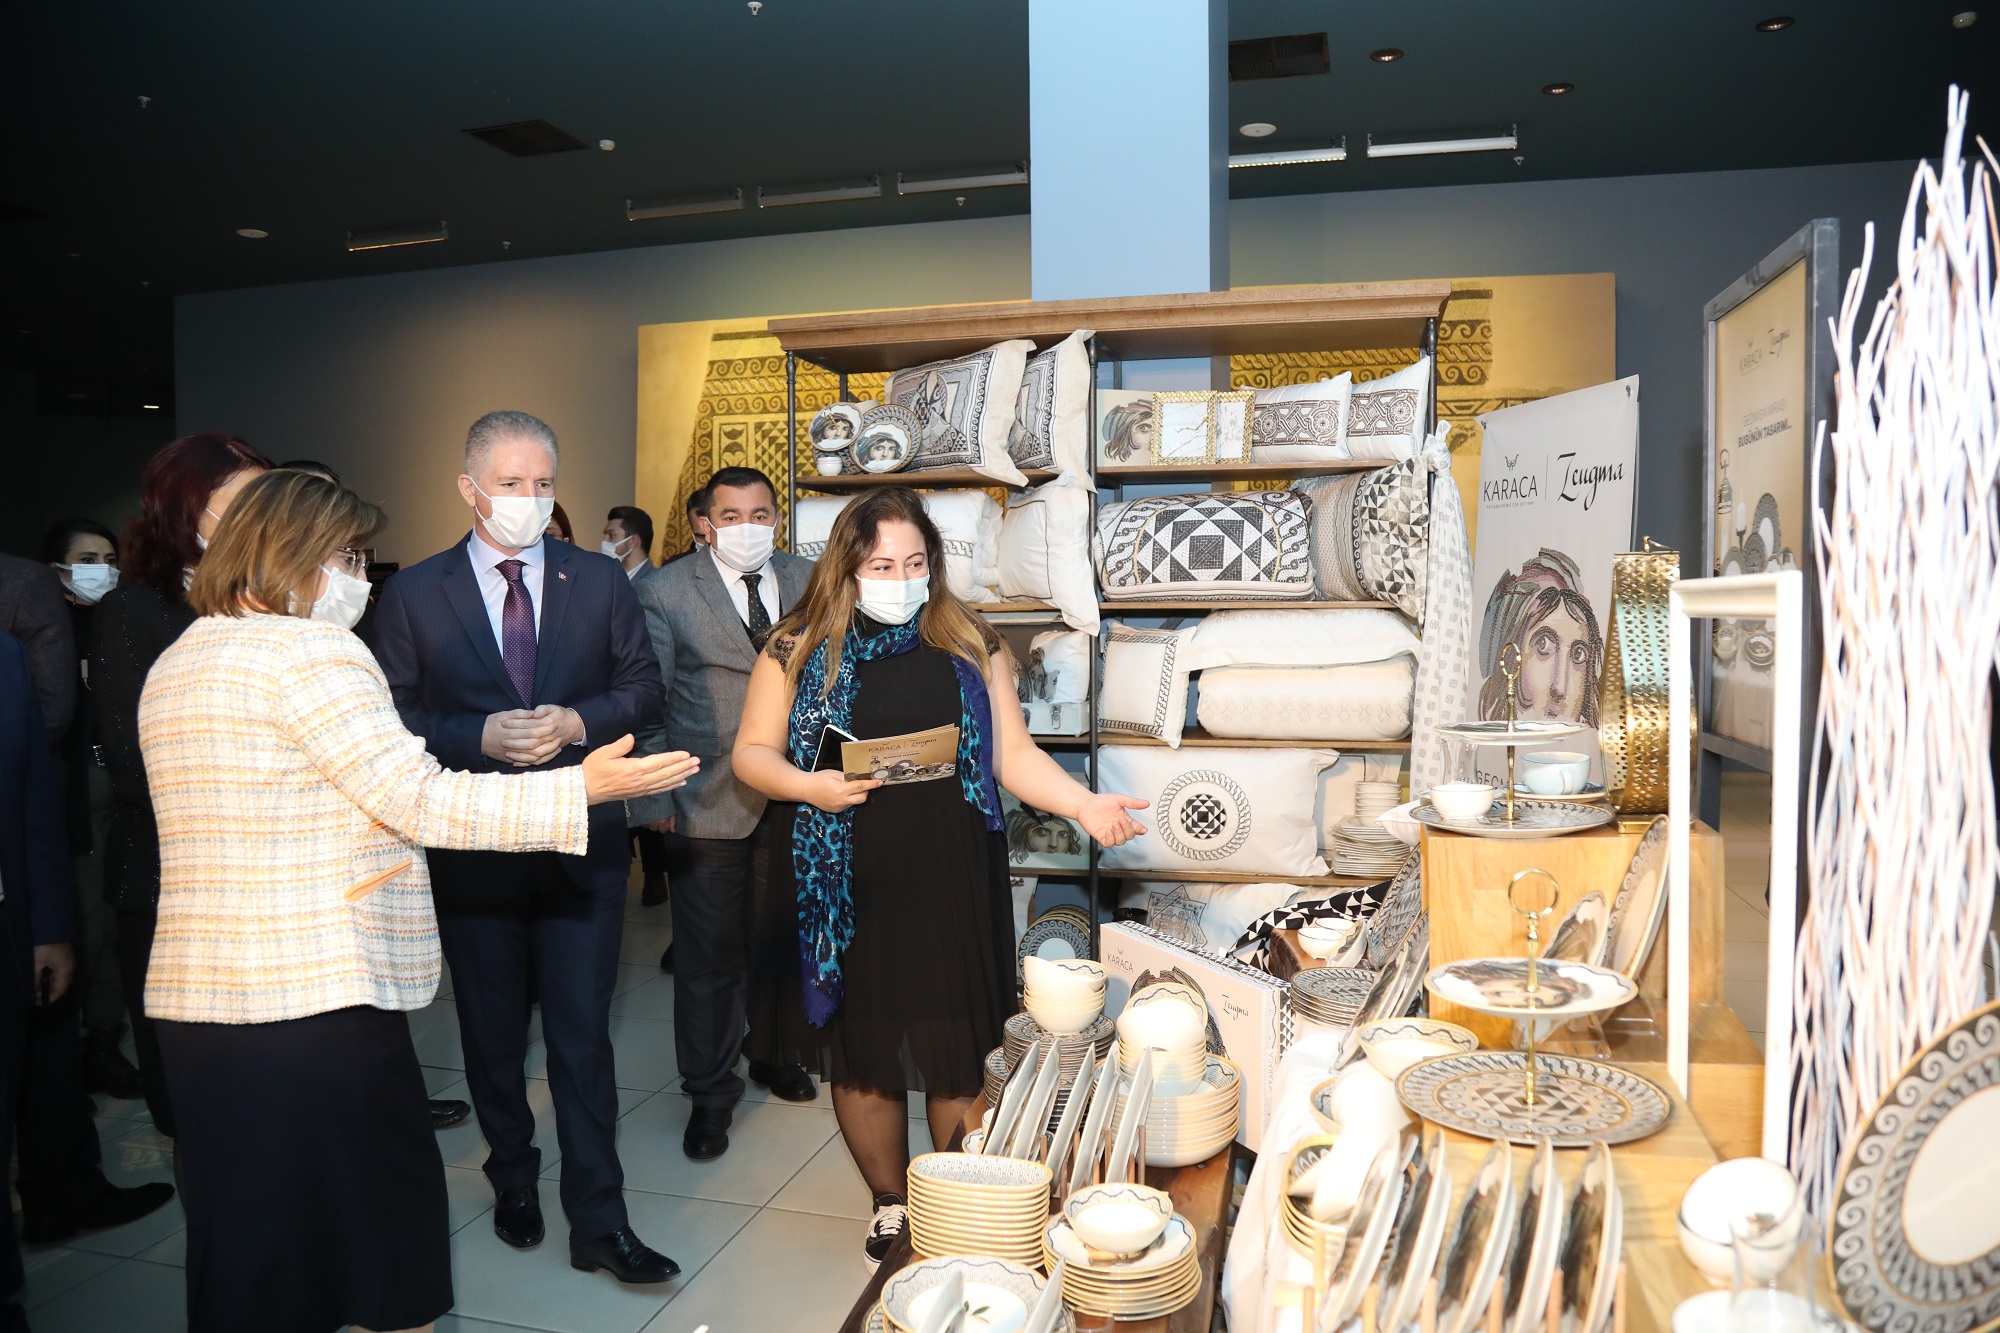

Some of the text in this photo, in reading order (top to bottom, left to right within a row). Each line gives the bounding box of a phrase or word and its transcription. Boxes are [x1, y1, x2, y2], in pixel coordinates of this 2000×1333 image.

[1483, 475, 1538, 502] KARACA
[868, 744, 902, 753] KARACA
[1107, 952, 1134, 973] KARACA
